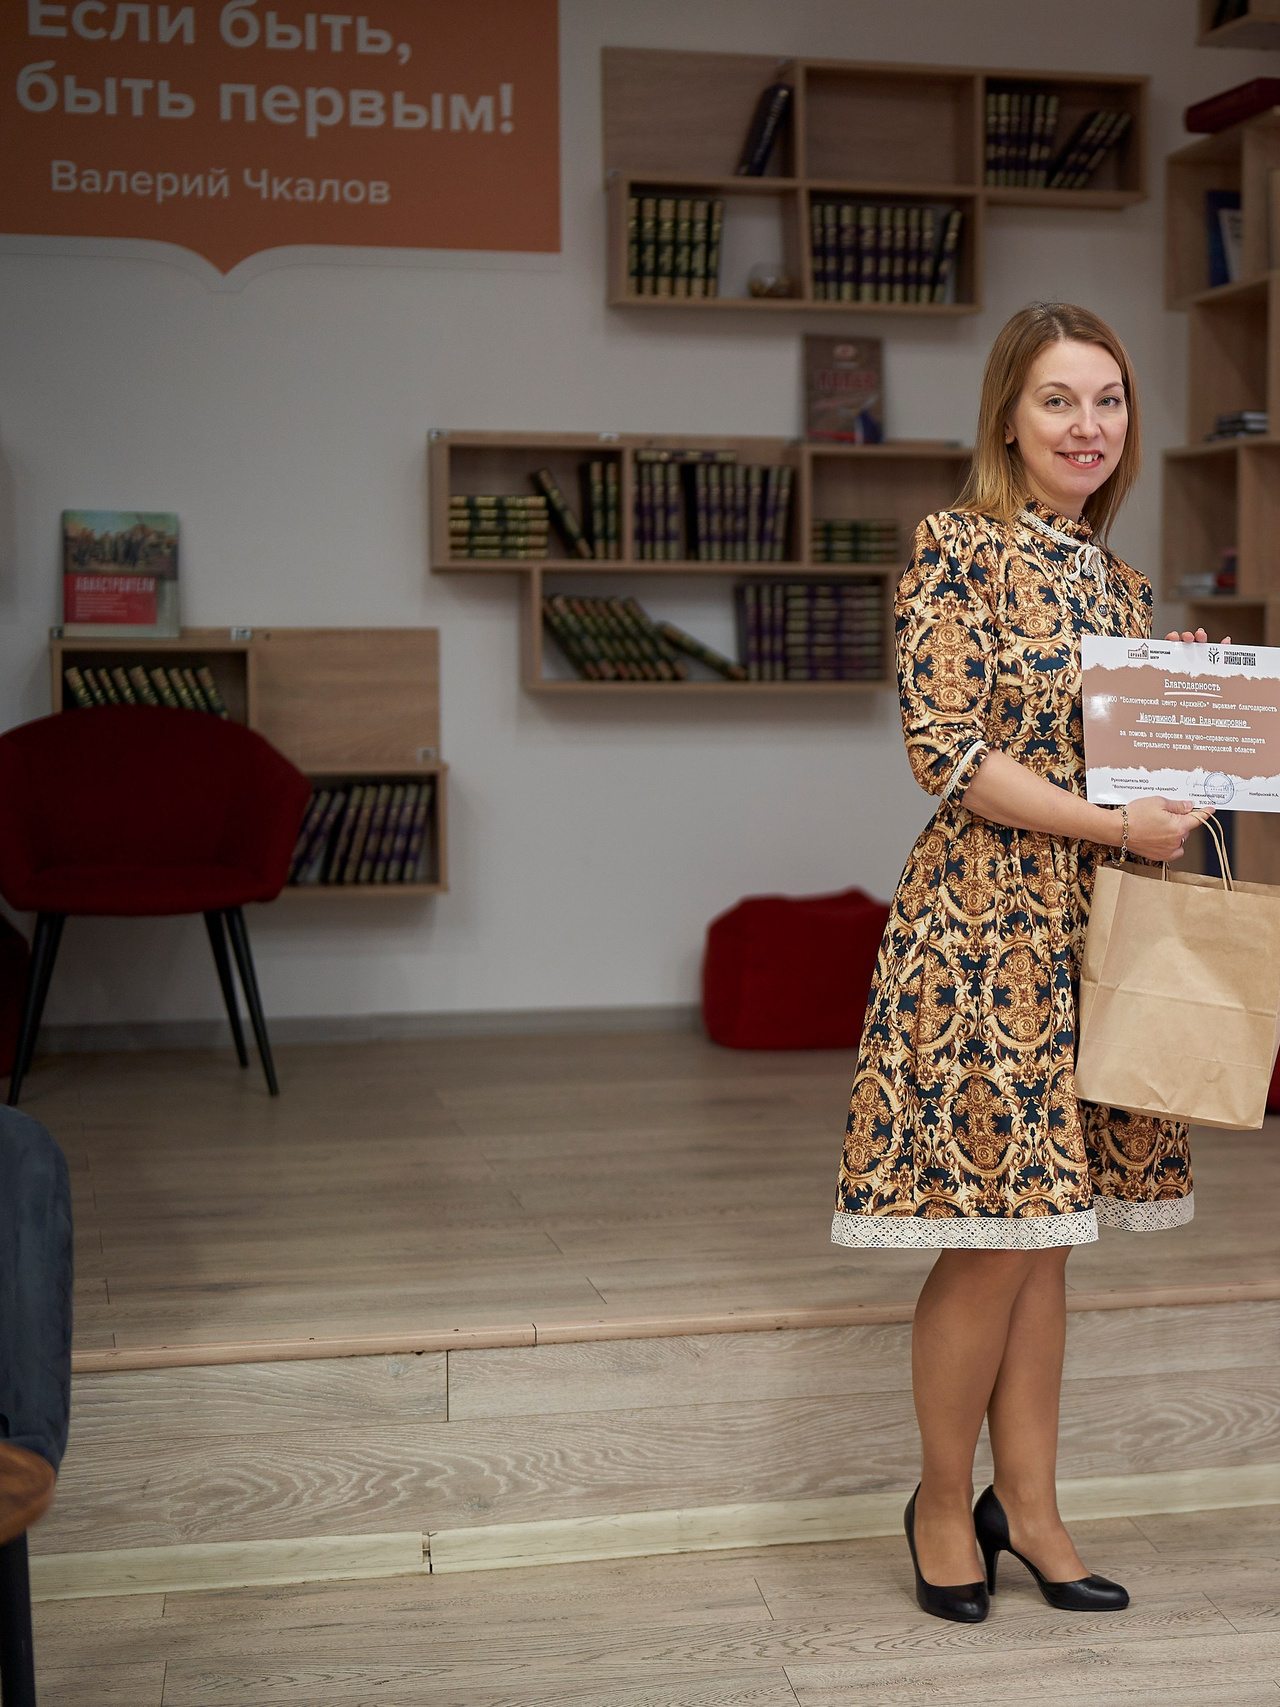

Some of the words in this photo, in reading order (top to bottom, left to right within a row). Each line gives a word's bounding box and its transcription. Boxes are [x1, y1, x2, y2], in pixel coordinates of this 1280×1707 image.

[26, 0, 196, 44] Если
[218, 0, 412, 65] быть,
[15, 60, 196, 119] быть
[218, 82, 514, 138] первым!
[50, 159, 230, 204] Валерий
[242, 167, 391, 205] Чкалов
[1164, 679, 1221, 692] Благодарность
[1212, 702, 1236, 710] выражает
[1238, 703, 1278, 713] благодарность
[1179, 714, 1196, 725] Дине
[1199, 716, 1247, 728] Владимировне
[1128, 730, 1147, 738] помощь
[1155, 731, 1183, 740] оцифровке
[1185, 733, 1240, 743] научно-справочного
[1241, 737, 1266, 745] аппарата
[1133, 740, 1170, 749] Центрального
[1172, 743, 1191, 751] архива
[1192, 743, 1233, 753] Нижегородской
[1234, 746, 1256, 754] области
